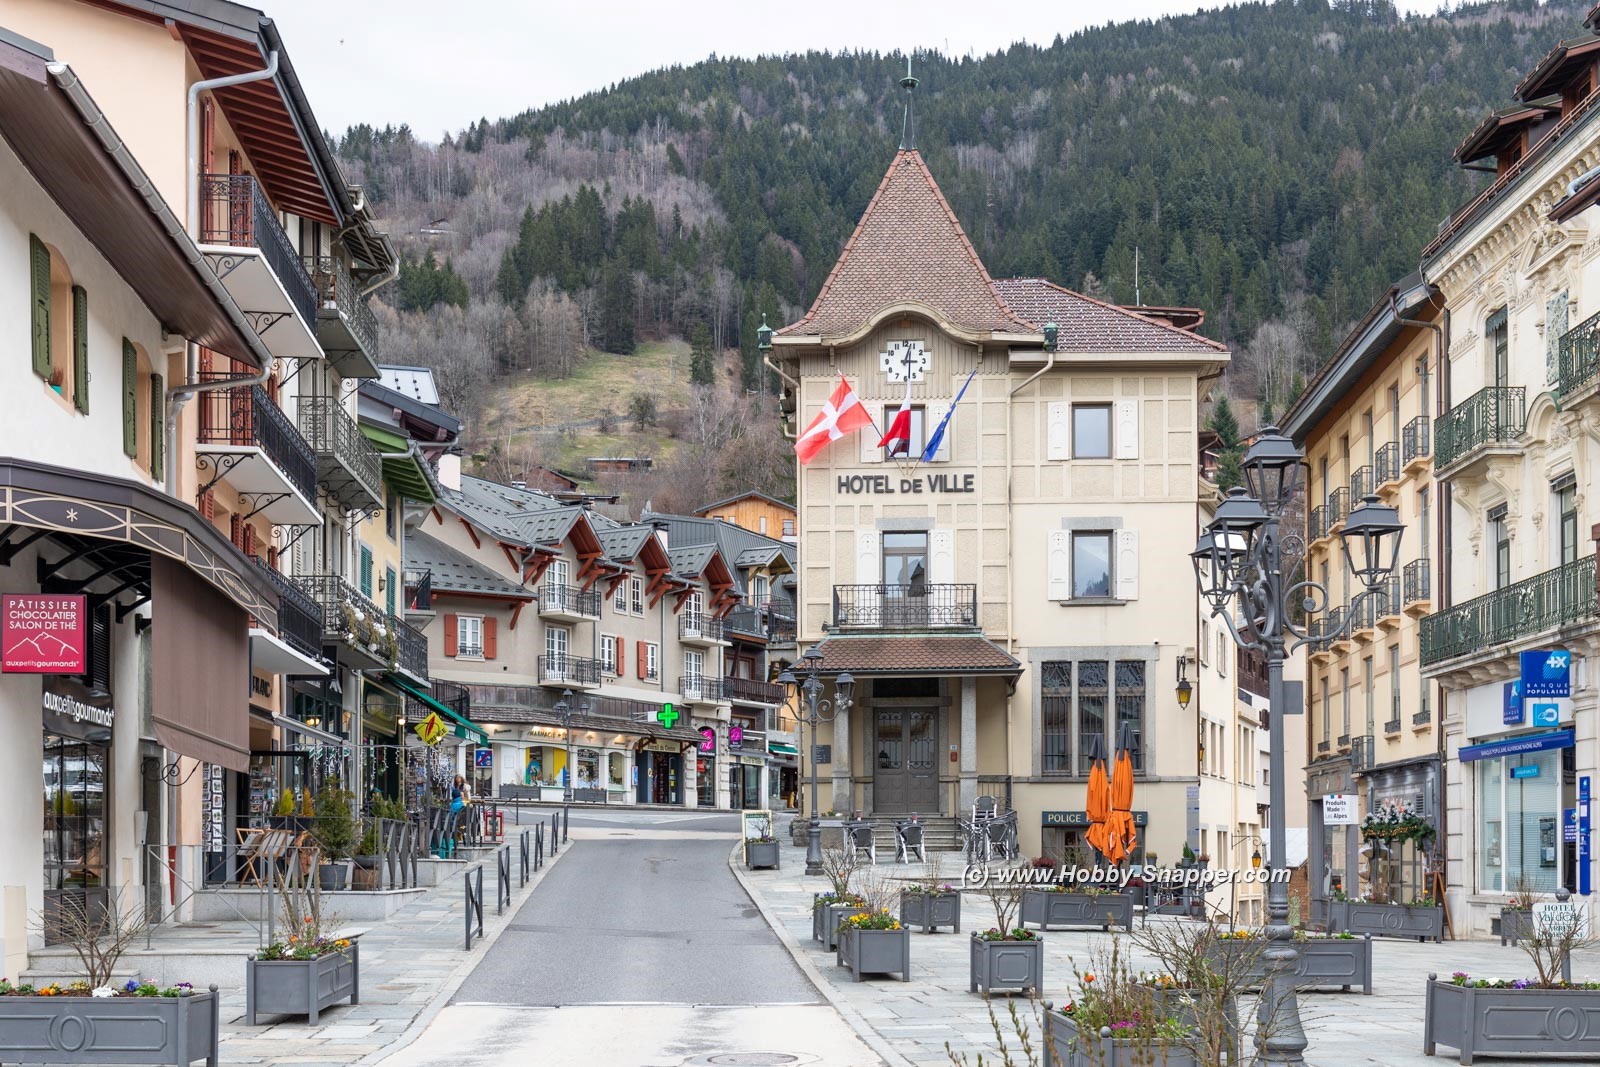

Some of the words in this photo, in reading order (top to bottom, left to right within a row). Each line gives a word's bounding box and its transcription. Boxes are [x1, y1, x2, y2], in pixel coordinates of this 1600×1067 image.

[837, 475, 895, 494] HOTEL
[900, 478, 923, 493] DE
[927, 474, 975, 493] VILLE
[9, 599, 77, 610] PÂTISSIER
[9, 610, 77, 620] CHOCOLATIER
[9, 620, 42, 630] SALON
[44, 621, 58, 630] DE
[60, 619, 77, 630] THÉ
[1048, 814, 1081, 823] POLICE
